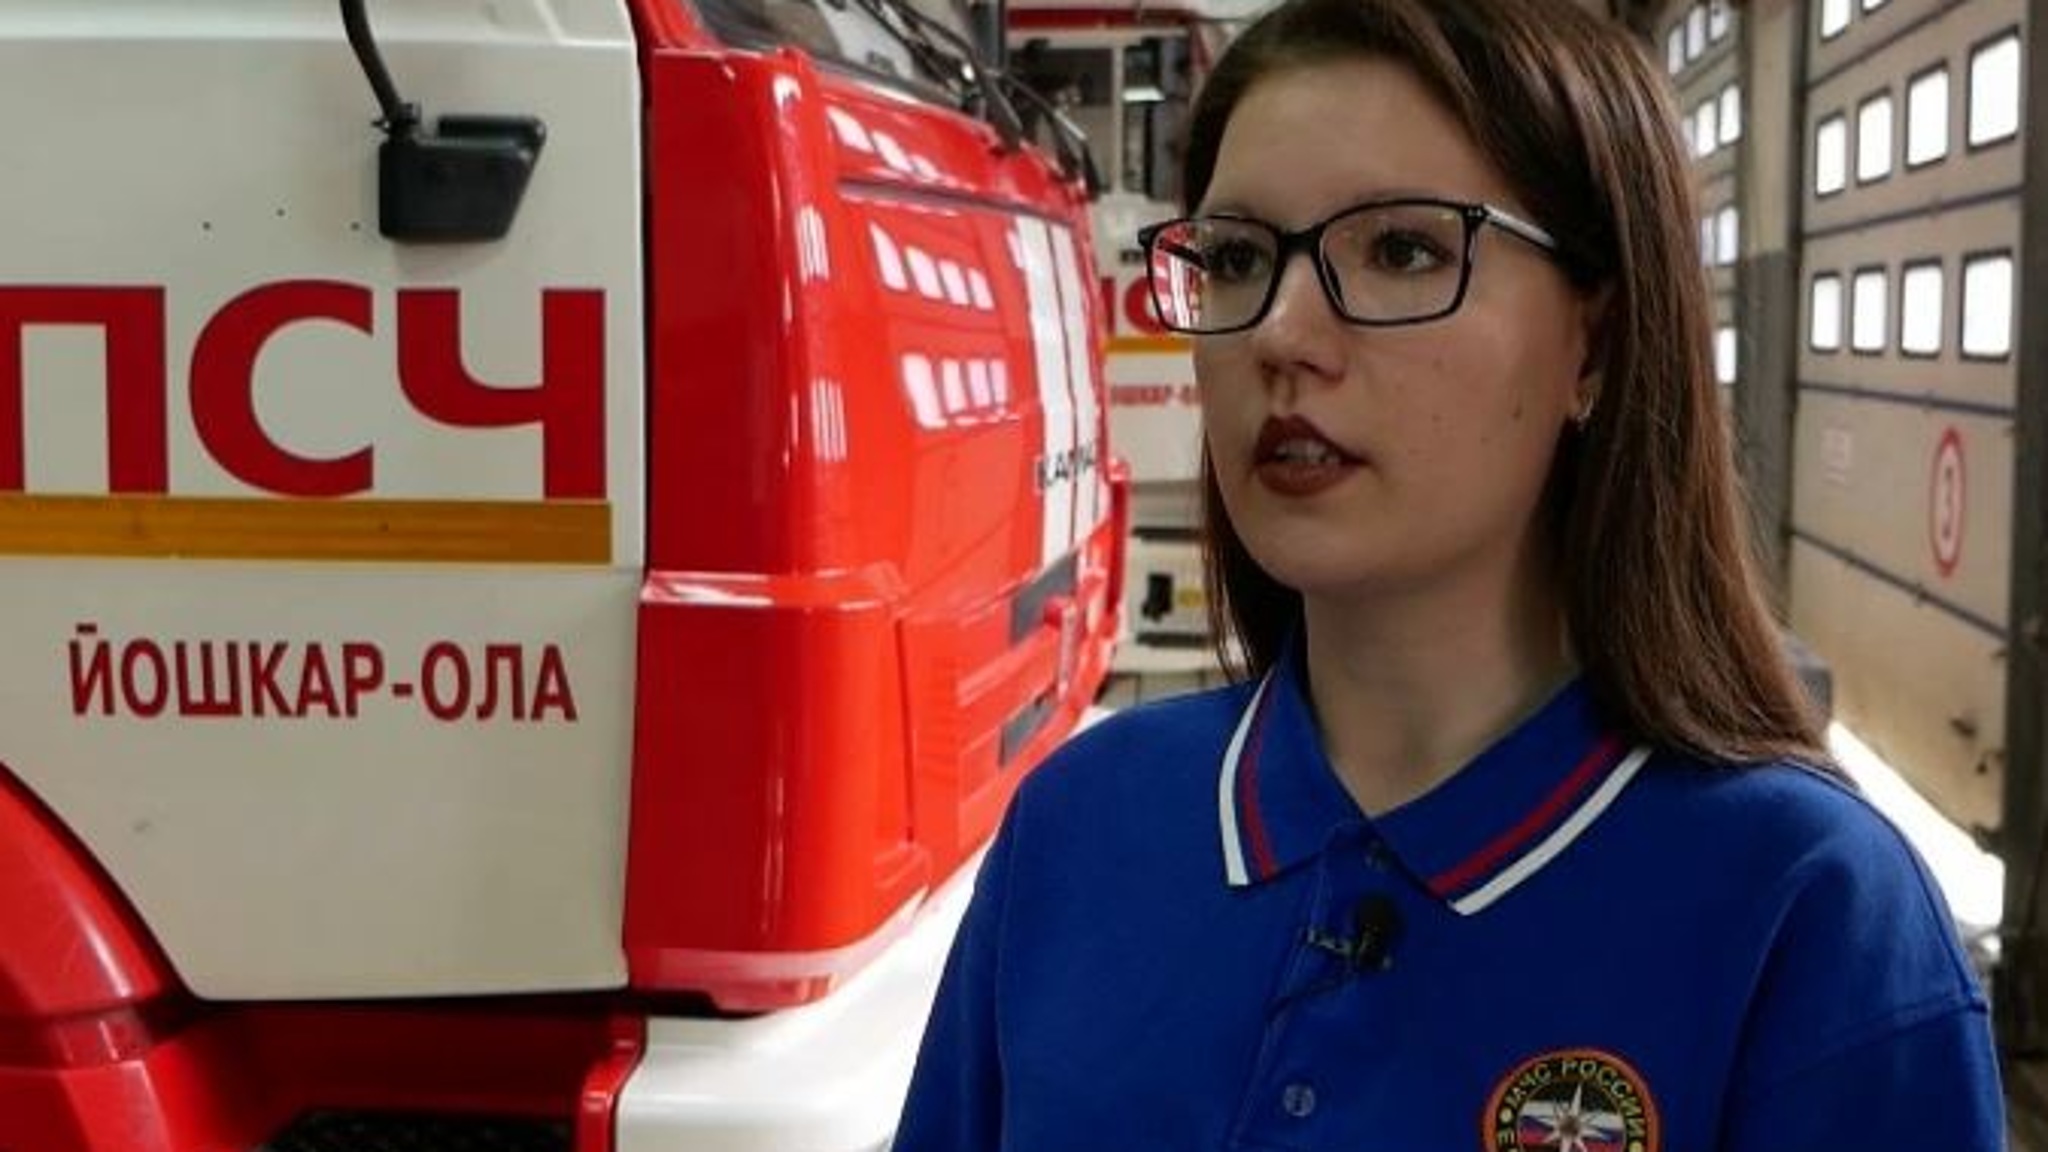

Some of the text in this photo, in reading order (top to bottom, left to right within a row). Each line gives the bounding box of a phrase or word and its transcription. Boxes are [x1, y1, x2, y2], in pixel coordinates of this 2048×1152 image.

[0, 280, 607, 499] ПСЧ
[68, 623, 578, 722] ЙОШКАР-ОЛА
[1504, 1060, 1646, 1139] МЧС РОССИИ
